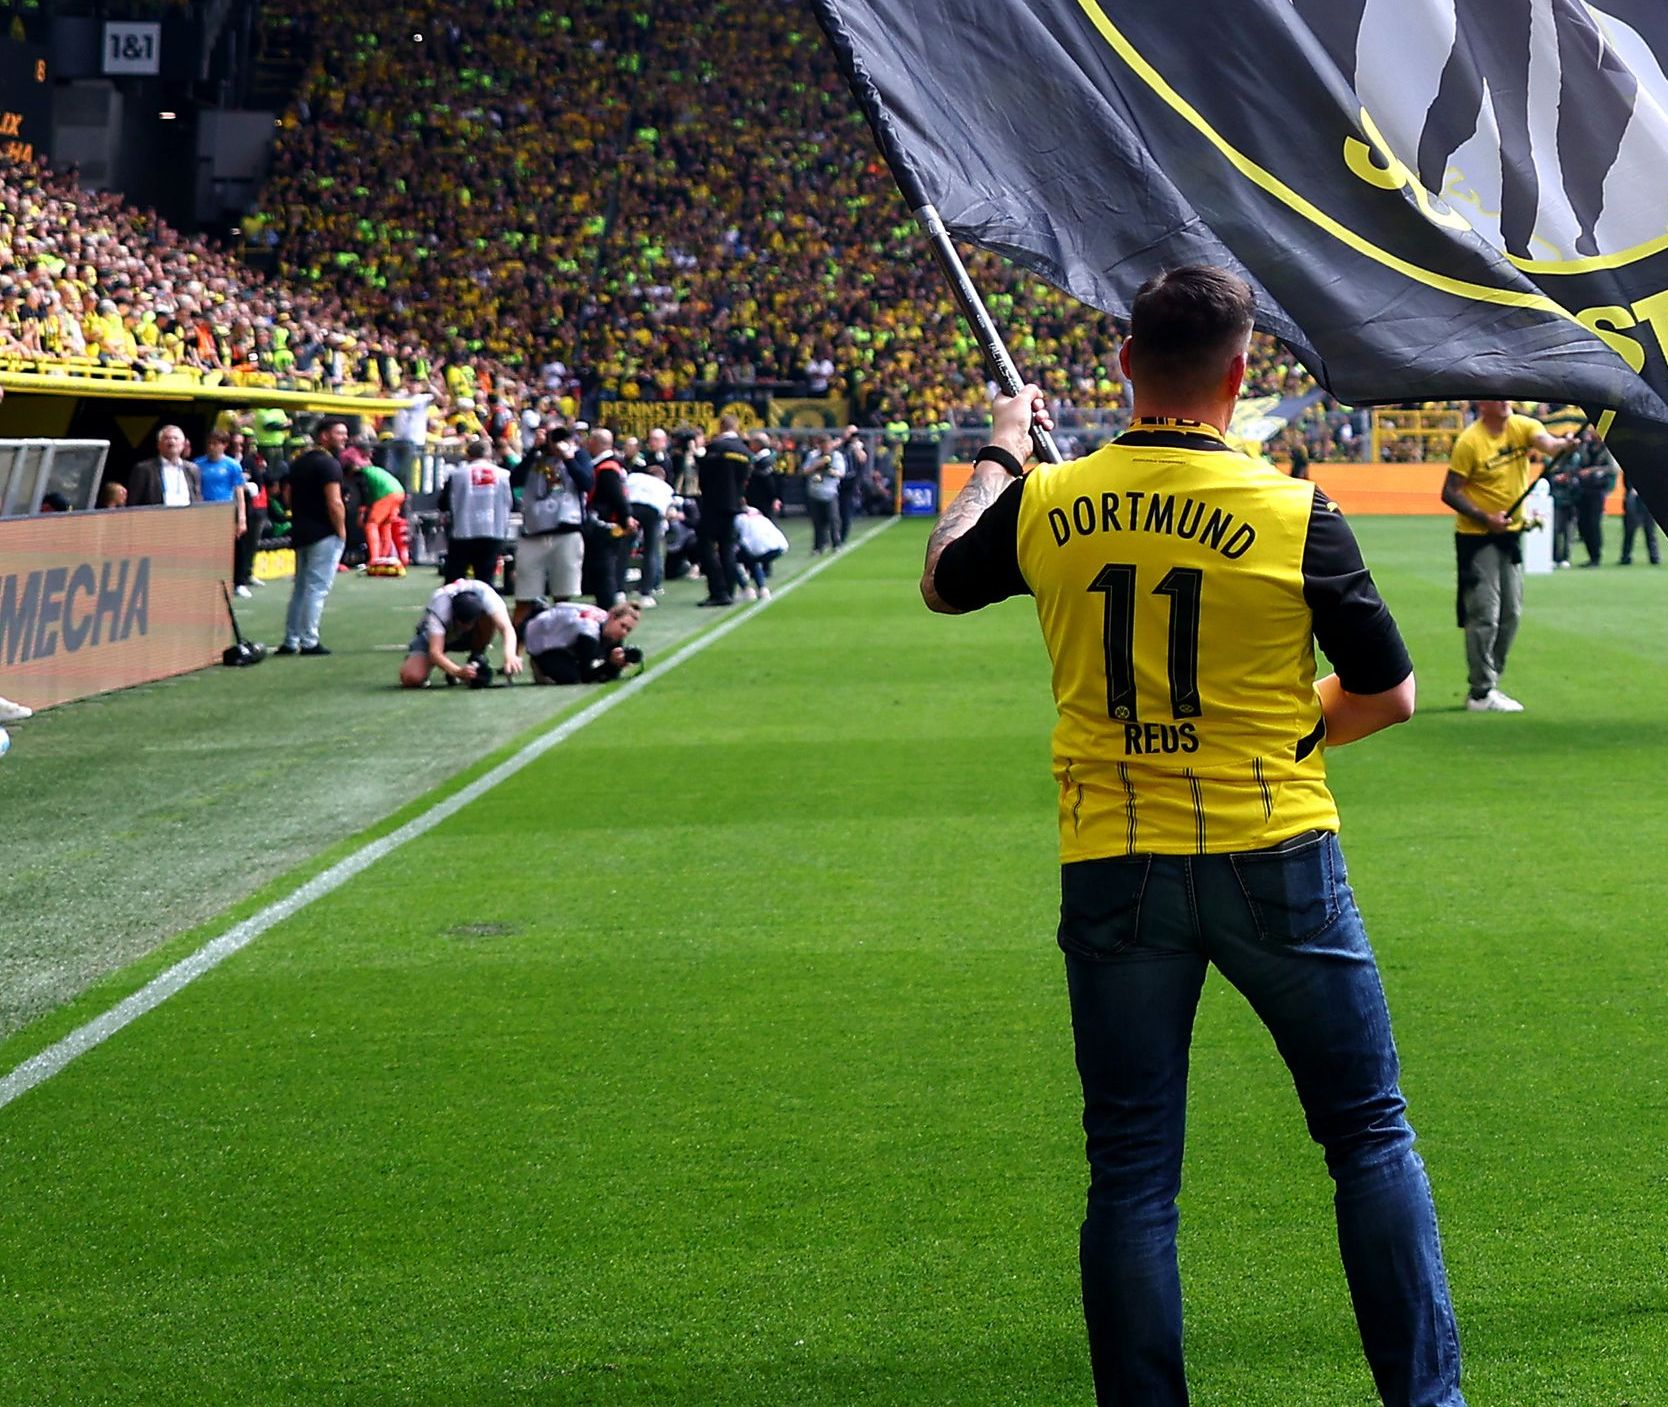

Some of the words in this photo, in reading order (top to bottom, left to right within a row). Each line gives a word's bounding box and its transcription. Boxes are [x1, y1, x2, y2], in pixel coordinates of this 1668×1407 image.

[110, 33, 154, 60] 1&1
[1047, 491, 1256, 560] DORTMUND
[0, 556, 151, 665] MECHA
[1087, 562, 1204, 723] 11
[1124, 722, 1200, 756] REUS
